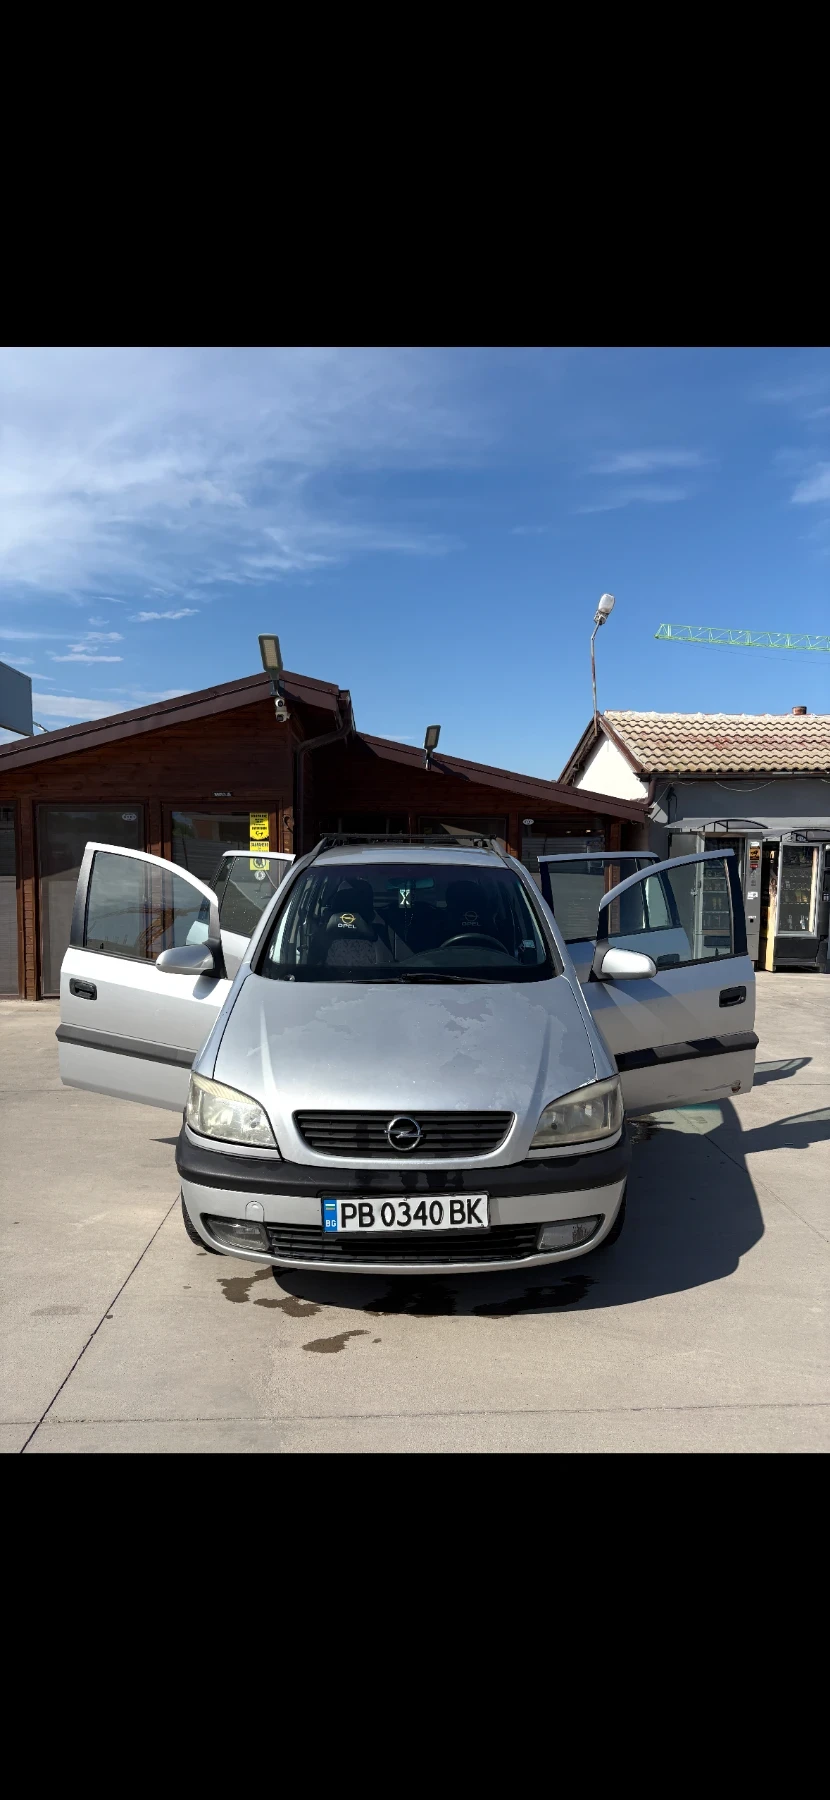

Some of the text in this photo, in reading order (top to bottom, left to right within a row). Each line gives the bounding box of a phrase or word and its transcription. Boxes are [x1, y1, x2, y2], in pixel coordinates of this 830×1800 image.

[340, 1197, 484, 1229] PB 0340 BK
[325, 1219, 337, 1228] BG
